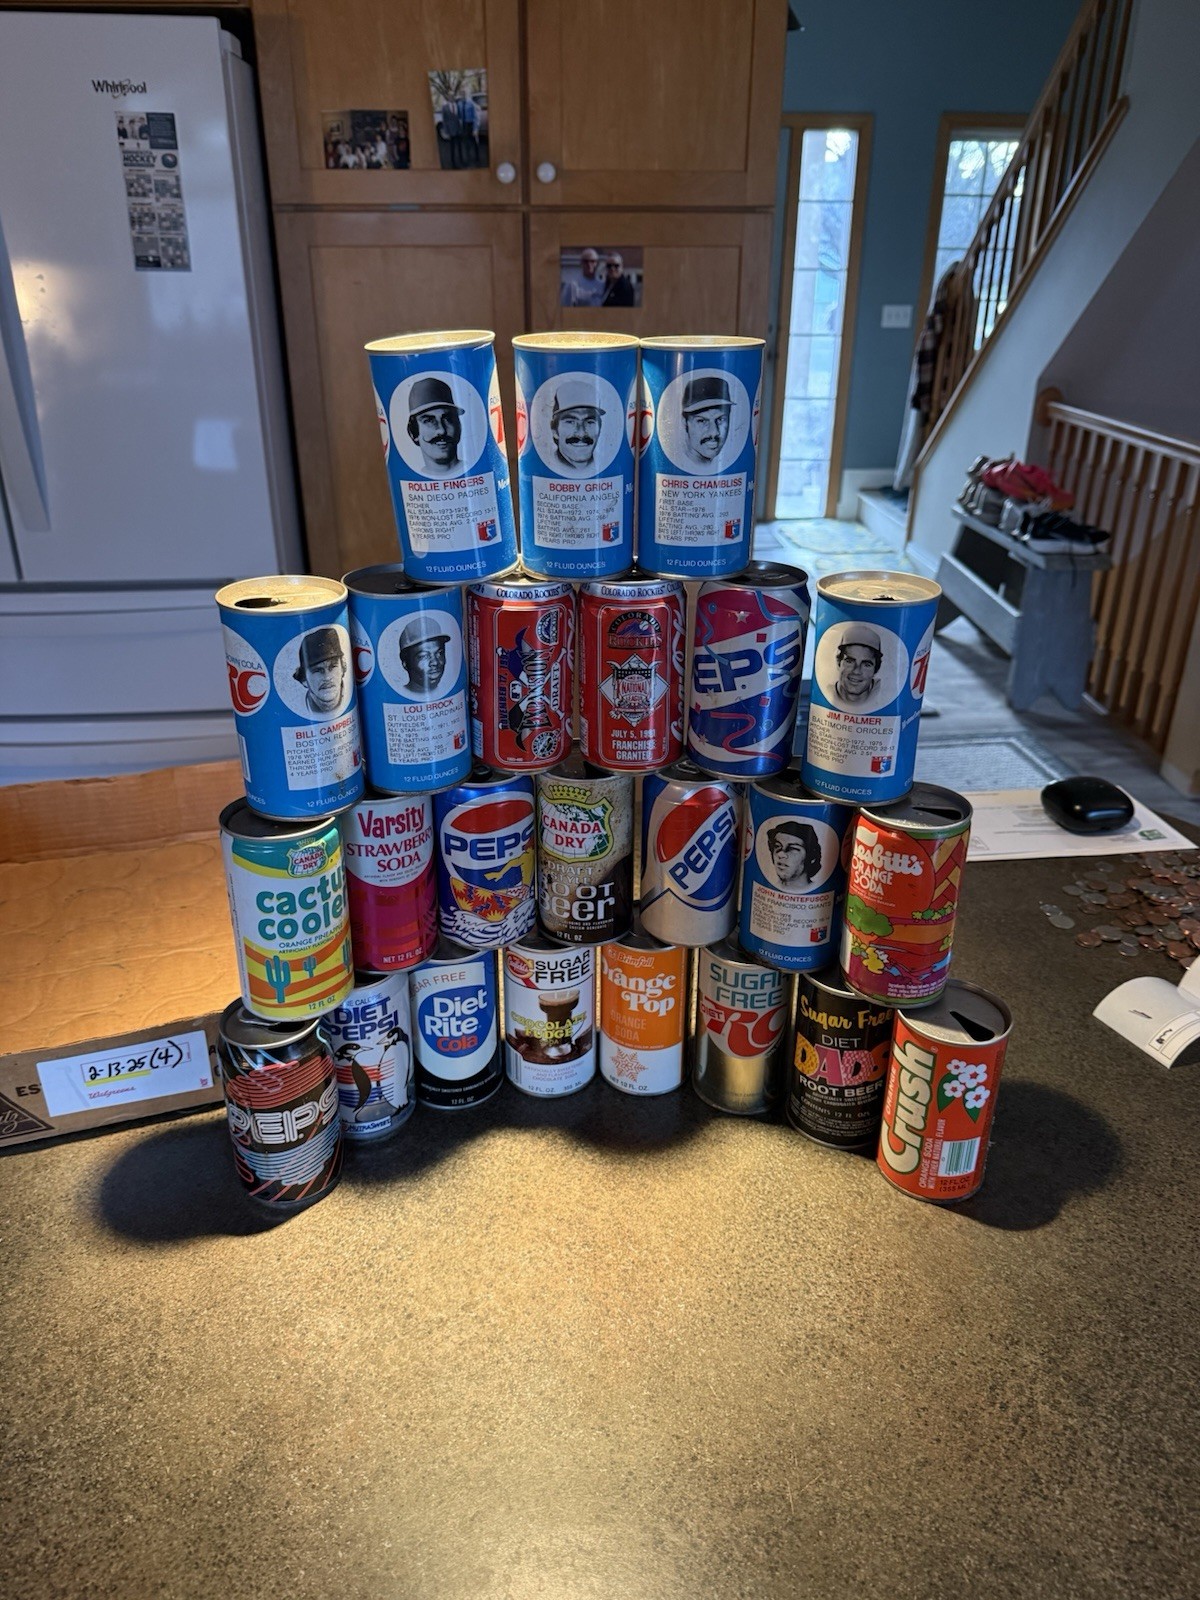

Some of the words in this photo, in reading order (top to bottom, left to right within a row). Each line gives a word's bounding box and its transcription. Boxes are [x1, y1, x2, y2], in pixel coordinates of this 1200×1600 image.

[91, 79, 147, 98] Whirlpool
[408, 482, 440, 492] ROLLIE
[443, 476, 485, 490] FINGERS
[549, 482, 581, 493] BOBBY
[584, 481, 613, 492] GRICH
[661, 479, 689, 489] CHRIS
[692, 477, 743, 489] CHAMBLISS
[408, 493, 424, 501] SAN
[427, 492, 454, 502] DIEGO
[457, 486, 489, 499] PADRES
[539, 492, 587, 502] CALIFORNIA
[589, 490, 620, 501] ANGELS
[661, 490, 679, 498] NEW
[682, 491, 705, 499] YORK
[708, 488, 742, 498] YANKEES
[536, 500, 559, 509] SECOND
[456, 509, 483, 519] RECORD
[425, 565, 432, 573] 12
[433, 564, 456, 573] FLUID
[456, 560, 487, 572] OUNCES
[554, 562, 575, 570] FLUID
[576, 561, 606, 570] OUNCES
[666, 558, 674, 566] 12
[674, 559, 696, 567] FLUID
[697, 558, 727, 567] OUNCES
[496, 587, 534, 600] COLORADO
[601, 585, 636, 597] COLORADO
[611, 611, 661, 631] COLORADO
[241, 660, 263, 671] COLA
[516, 646, 555, 731] EXPANSION
[552, 667, 560, 707] DRAFT
[402, 714, 427, 722] LOUIS
[429, 702, 464, 719] CARDINALS
[403, 705, 423, 714] LOU
[426, 698, 454, 712] BROCK
[811, 715, 853, 732] BALTIMORE
[855, 727, 894, 735] ORIOLES
[826, 711, 841, 721] JIM
[843, 715, 882, 726] PALMER
[295, 730, 316, 740] BILL
[295, 736, 331, 748] BOSTON
[333, 731, 347, 740] RED
[611, 729, 627, 739] JULY
[611, 740, 656, 750] FRANCHISE
[829, 745, 843, 754] RUN
[850, 743, 878, 751] RECORD
[616, 750, 653, 761] GRANTED
[829, 750, 848, 759] RIGHT
[831, 756, 844, 764] PRO
[296, 769, 319, 777] YEARS
[320, 766, 333, 774] PRO
[412, 774, 433, 782] FLUID
[433, 766, 459, 779] OUNCES
[316, 796, 337, 807] FLUID
[337, 785, 359, 801] OUNCES
[821, 781, 840, 792] FLUID
[840, 786, 873, 796] OUNCES
[357, 802, 426, 839] Varsity
[542, 814, 602, 833] CANADA
[554, 833, 586, 849] DRY
[668, 806, 737, 890] PEPSI
[293, 850, 324, 865] CANADA
[302, 860, 319, 871] DRY
[377, 852, 422, 873] SODA
[547, 860, 593, 875] DRAFT
[851, 855, 894, 886] ORANGE
[550, 871, 590, 885] STYLE
[853, 870, 884, 896] SODA
[539, 874, 615, 900] ROOT
[756, 885, 775, 897] JOHN
[777, 893, 830, 903] MONTEFUSCO
[754, 891, 766, 902] SAN
[766, 897, 807, 910] FRANCISCO
[808, 900, 832, 910] GIANTS
[279, 936, 313, 949] ORANGE
[383, 955, 396, 964] NET
[397, 953, 405, 962] 12
[535, 949, 590, 971] SUGAR
[783, 955, 812, 963] OUNCES
[433, 971, 467, 985] FREE
[535, 960, 590, 984] FREE
[433, 988, 488, 1018] Diet
[621, 990, 676, 1017] Pop
[715, 985, 783, 1010] FREE
[308, 1002, 317, 1011] 12
[334, 996, 391, 1025] DIET
[700, 1003, 724, 1020] DIET
[799, 994, 853, 1031] Sugar
[857, 1008, 893, 1030] Free
[331, 1009, 399, 1041] PEPSI
[424, 1014, 479, 1038] Rite
[511, 1010, 587, 1030] CHOCOLATE
[611, 1008, 647, 1030] ORANGE
[704, 995, 788, 1058] RC
[525, 1027, 573, 1040] FUDGE
[614, 1024, 640, 1041] SODA
[436, 1034, 479, 1053] Cola
[821, 1033, 862, 1049] DIET
[150, 1040, 183, 1069] (4)
[609, 1074, 619, 1084] NET
[799, 1074, 839, 1098] ROOT
[844, 1079, 884, 1098] BEER
[15, 1083, 42, 1097] ES
[88, 1086, 137, 1100] Walgreens
[800, 1095, 831, 1115] CONTENTS
[881, 1041, 936, 1173] Crush
[935, 1118, 946, 1138] FLAVOR
[923, 1137, 934, 1157] SODA
[932, 1138, 943, 1160] NATURAL
[918, 1158, 931, 1188] ORANGE
[929, 1159, 939, 1177] OTHER
[927, 1176, 937, 1189] WITH
